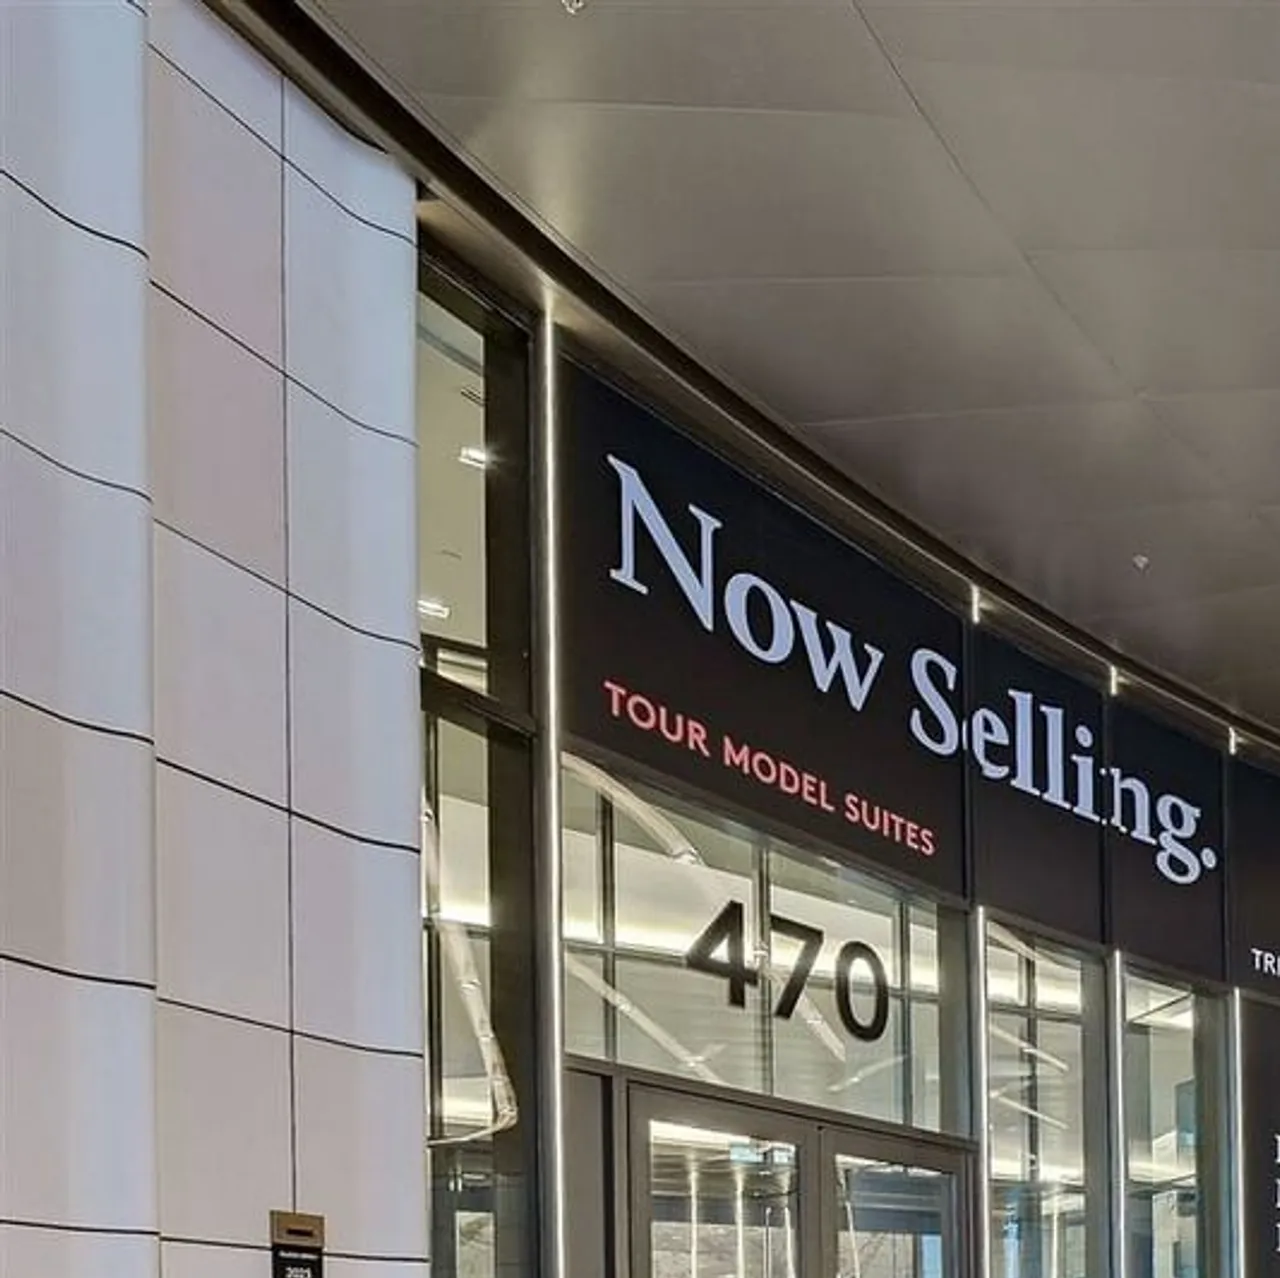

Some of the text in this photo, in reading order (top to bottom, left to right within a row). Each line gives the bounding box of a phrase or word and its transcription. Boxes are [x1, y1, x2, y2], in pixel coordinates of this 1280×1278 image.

[606, 454, 1218, 885] Now Selling.
[603, 680, 937, 857] TOUR MODEL SUITES
[685, 899, 891, 1043] 470
